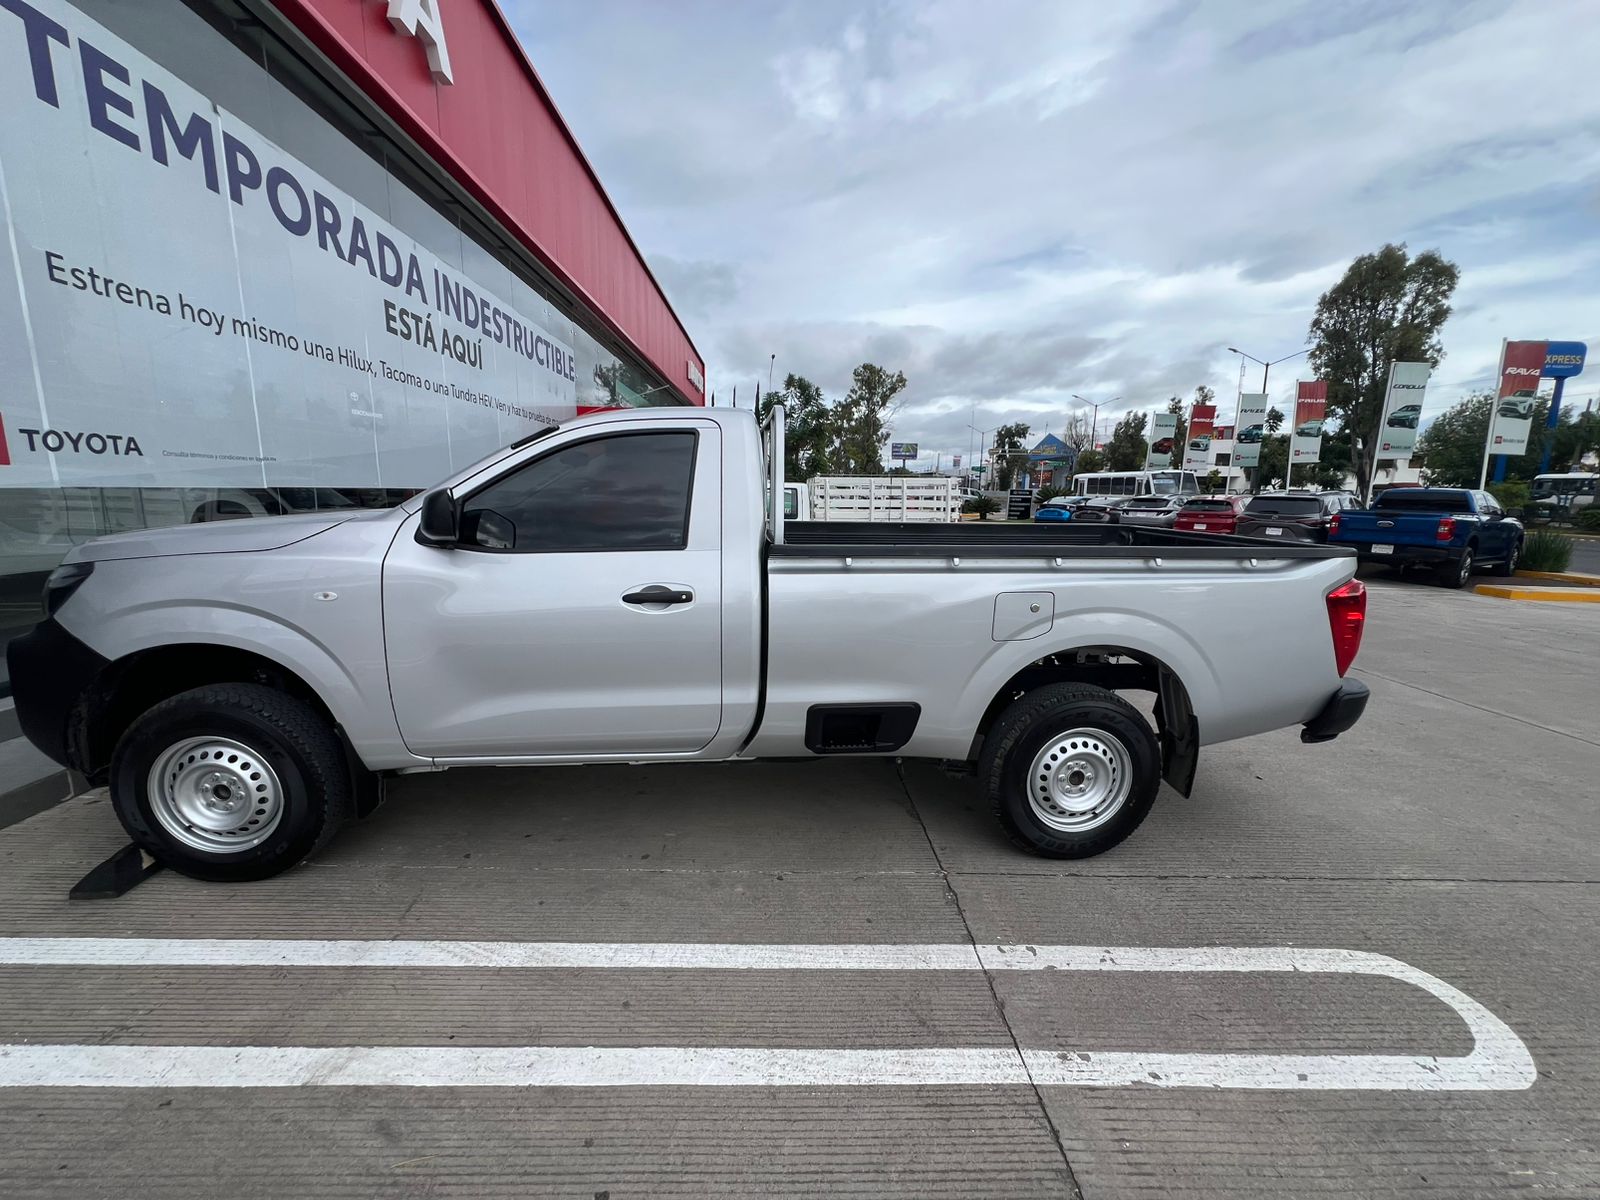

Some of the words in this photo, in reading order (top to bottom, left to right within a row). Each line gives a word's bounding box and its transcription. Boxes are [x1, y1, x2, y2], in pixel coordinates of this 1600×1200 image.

[0, 0, 428, 305] TEMPORADA
[434, 268, 575, 382] INDESTRUCTIBLE
[45, 250, 171, 315] Estrena
[179, 293, 225, 335] hoy
[232, 317, 299, 351] mismo
[304, 340, 334, 362] una
[338, 346, 377, 378] Hilux,
[379, 360, 422, 388] Tacoma
[424, 379, 431, 391] o
[433, 381, 449, 396] una
[451, 383, 478, 404] Tundra
[479, 392, 494, 409] HEV.
[495, 398, 506, 412] Ven
[511, 403, 521, 417] haz
[384, 299, 437, 353] ESTÁ
[441, 328, 482, 370] AQUÍ
[1505, 367, 1541, 376] RAV4
[1544, 354, 1582, 365] XPRESS
[18, 428, 144, 456] TOYOTA
